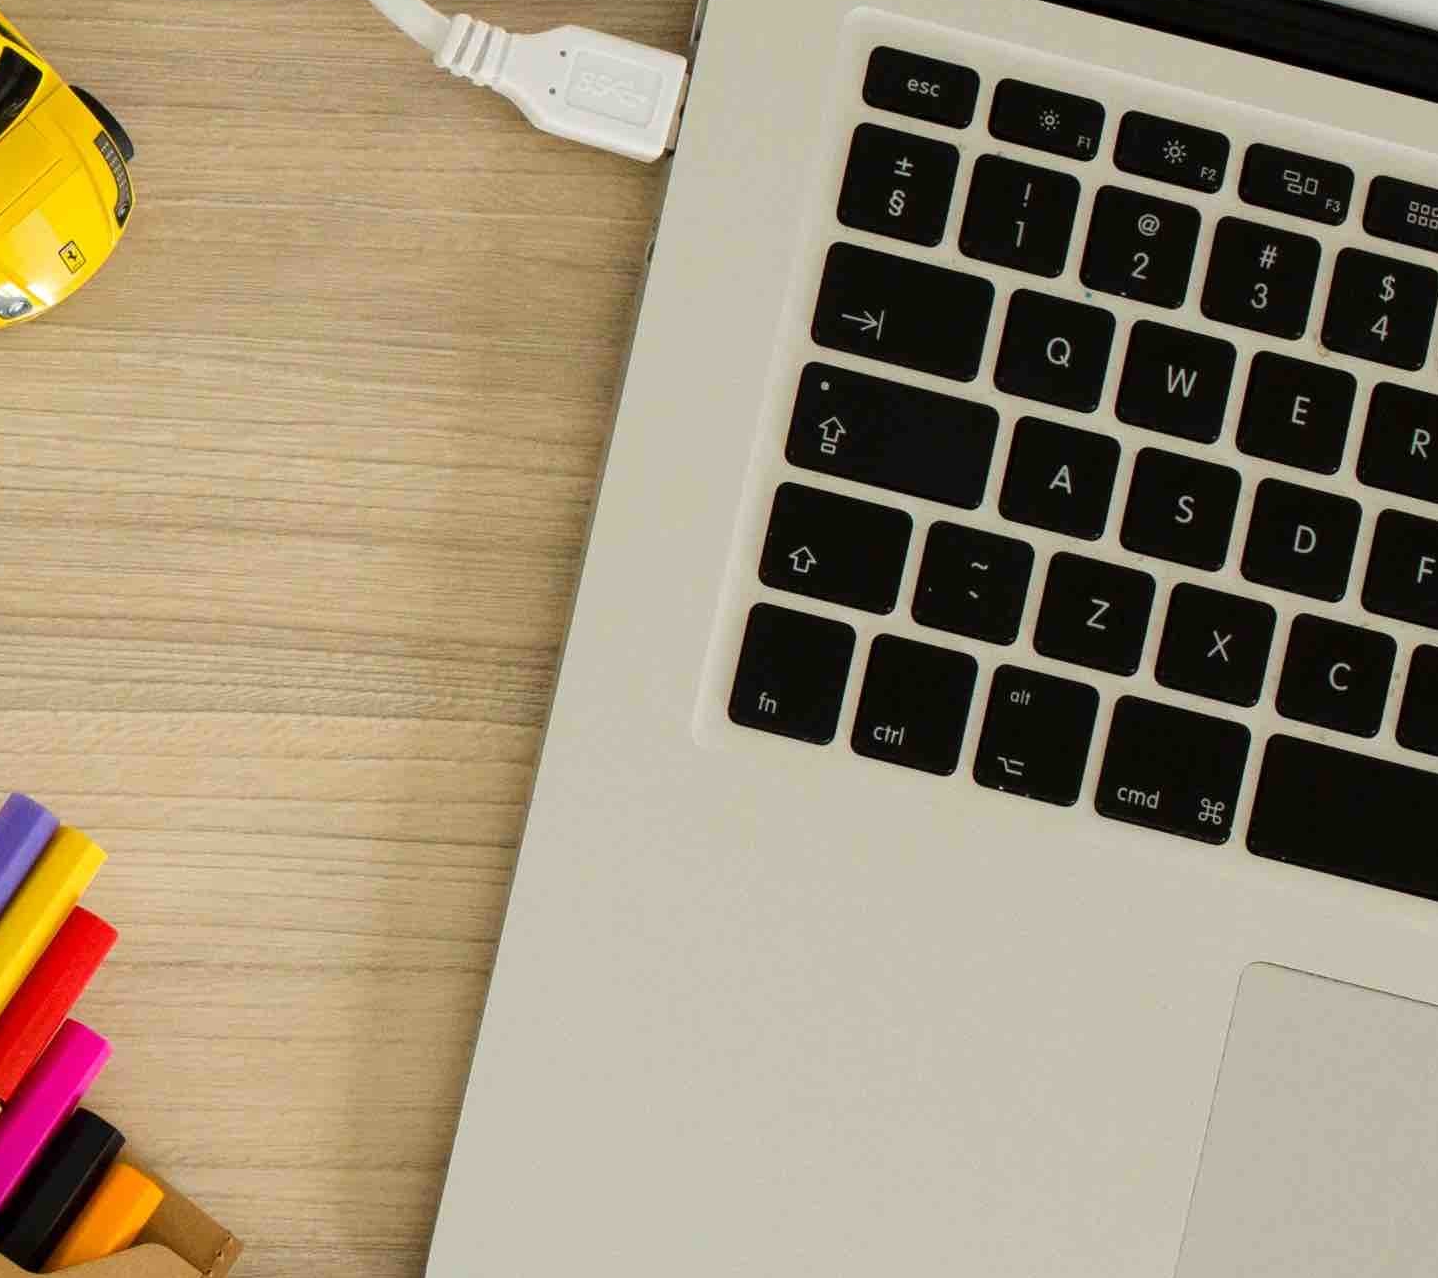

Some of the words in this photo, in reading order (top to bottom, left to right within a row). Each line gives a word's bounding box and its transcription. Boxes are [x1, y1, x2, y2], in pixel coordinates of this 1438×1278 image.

[907, 79, 940, 97] esc
[1077, 135, 1094, 150] F1
[1200, 166, 1217, 182] F2
[1325, 198, 1341, 213] F3
[1132, 252, 1150, 280] 2
[1251, 283, 1268, 309] 3
[1370, 315, 1388, 341] 4
[1046, 337, 1071, 368] Q
[1168, 365, 1198, 397] W
[1292, 395, 1311, 425] E
[1410, 428, 1431, 458] R
[1049, 465, 1072, 494] A
[1175, 495, 1194, 523] S
[1294, 525, 1317, 554] D
[1417, 556, 1436, 583] F
[1086, 599, 1110, 630] Z
[1207, 630, 1232, 662] X
[1329, 663, 1351, 691] C
[758, 691, 777, 714] fn
[1010, 690, 1031, 706] alt
[873, 725, 905, 746] ctrl
[1117, 787, 1160, 809] cmd
